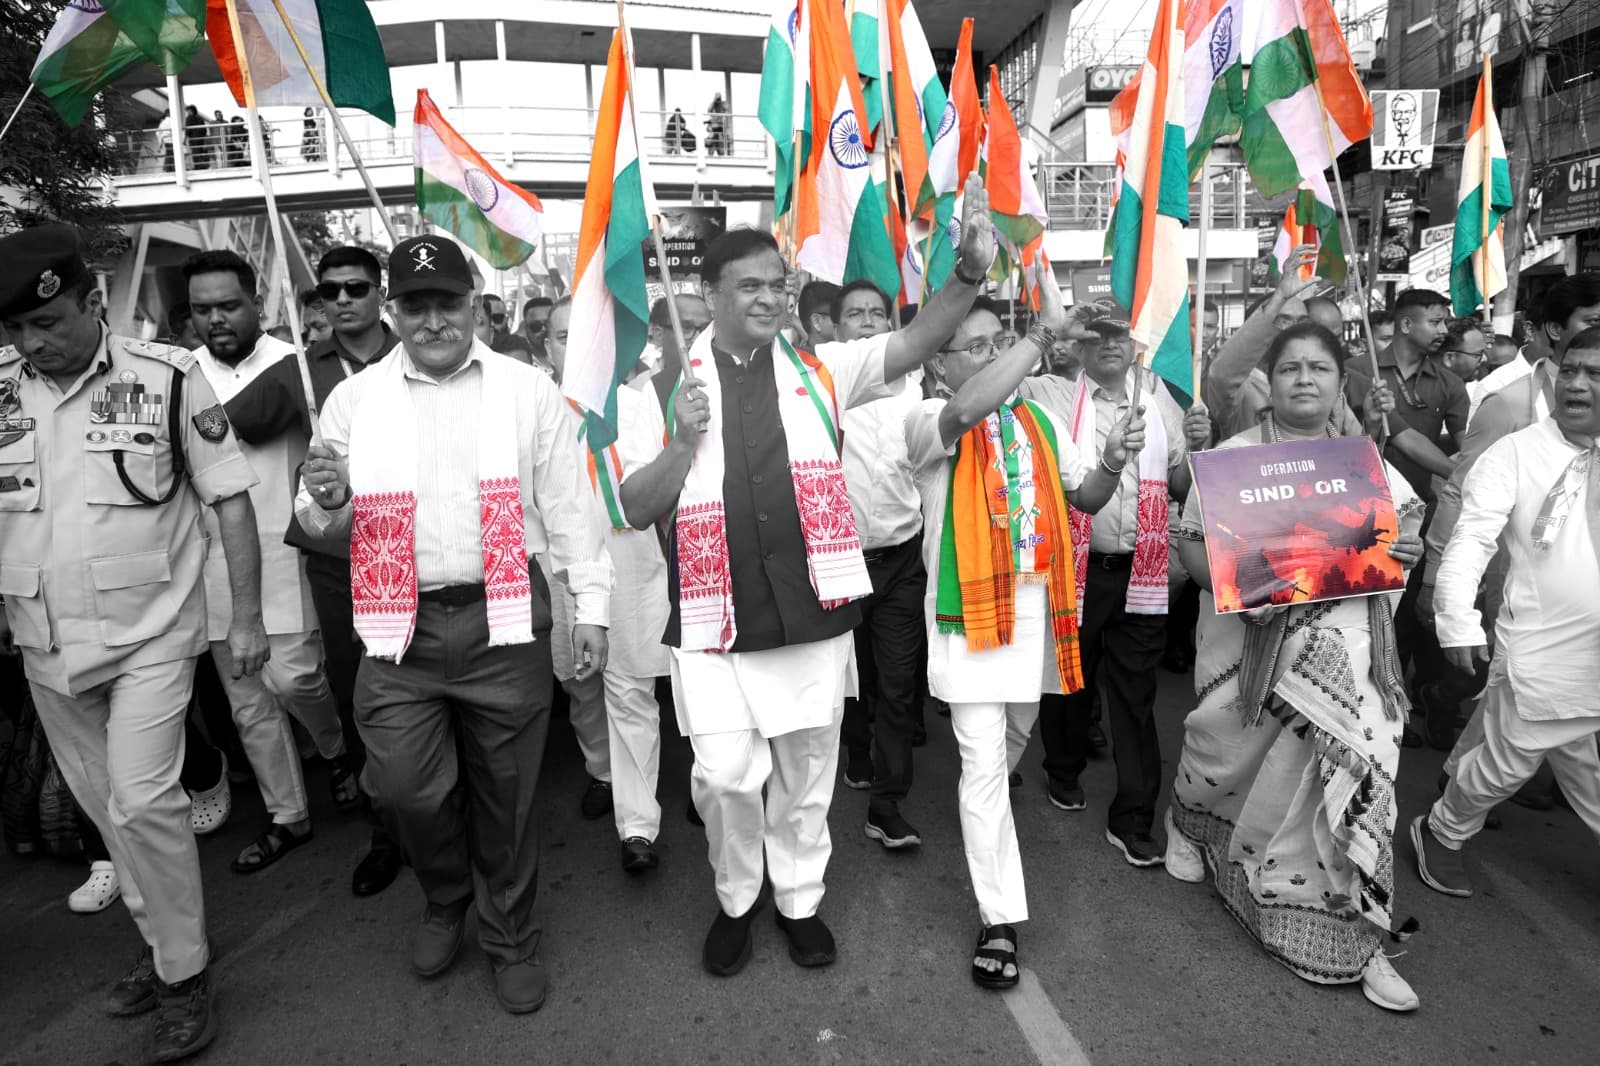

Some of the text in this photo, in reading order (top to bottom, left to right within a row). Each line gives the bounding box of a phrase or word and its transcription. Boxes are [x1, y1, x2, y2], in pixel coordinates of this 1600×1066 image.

[1381, 149, 1423, 165] KFC
[1088, 285, 1111, 293] SIND
[1260, 459, 1317, 477] OPERATION
